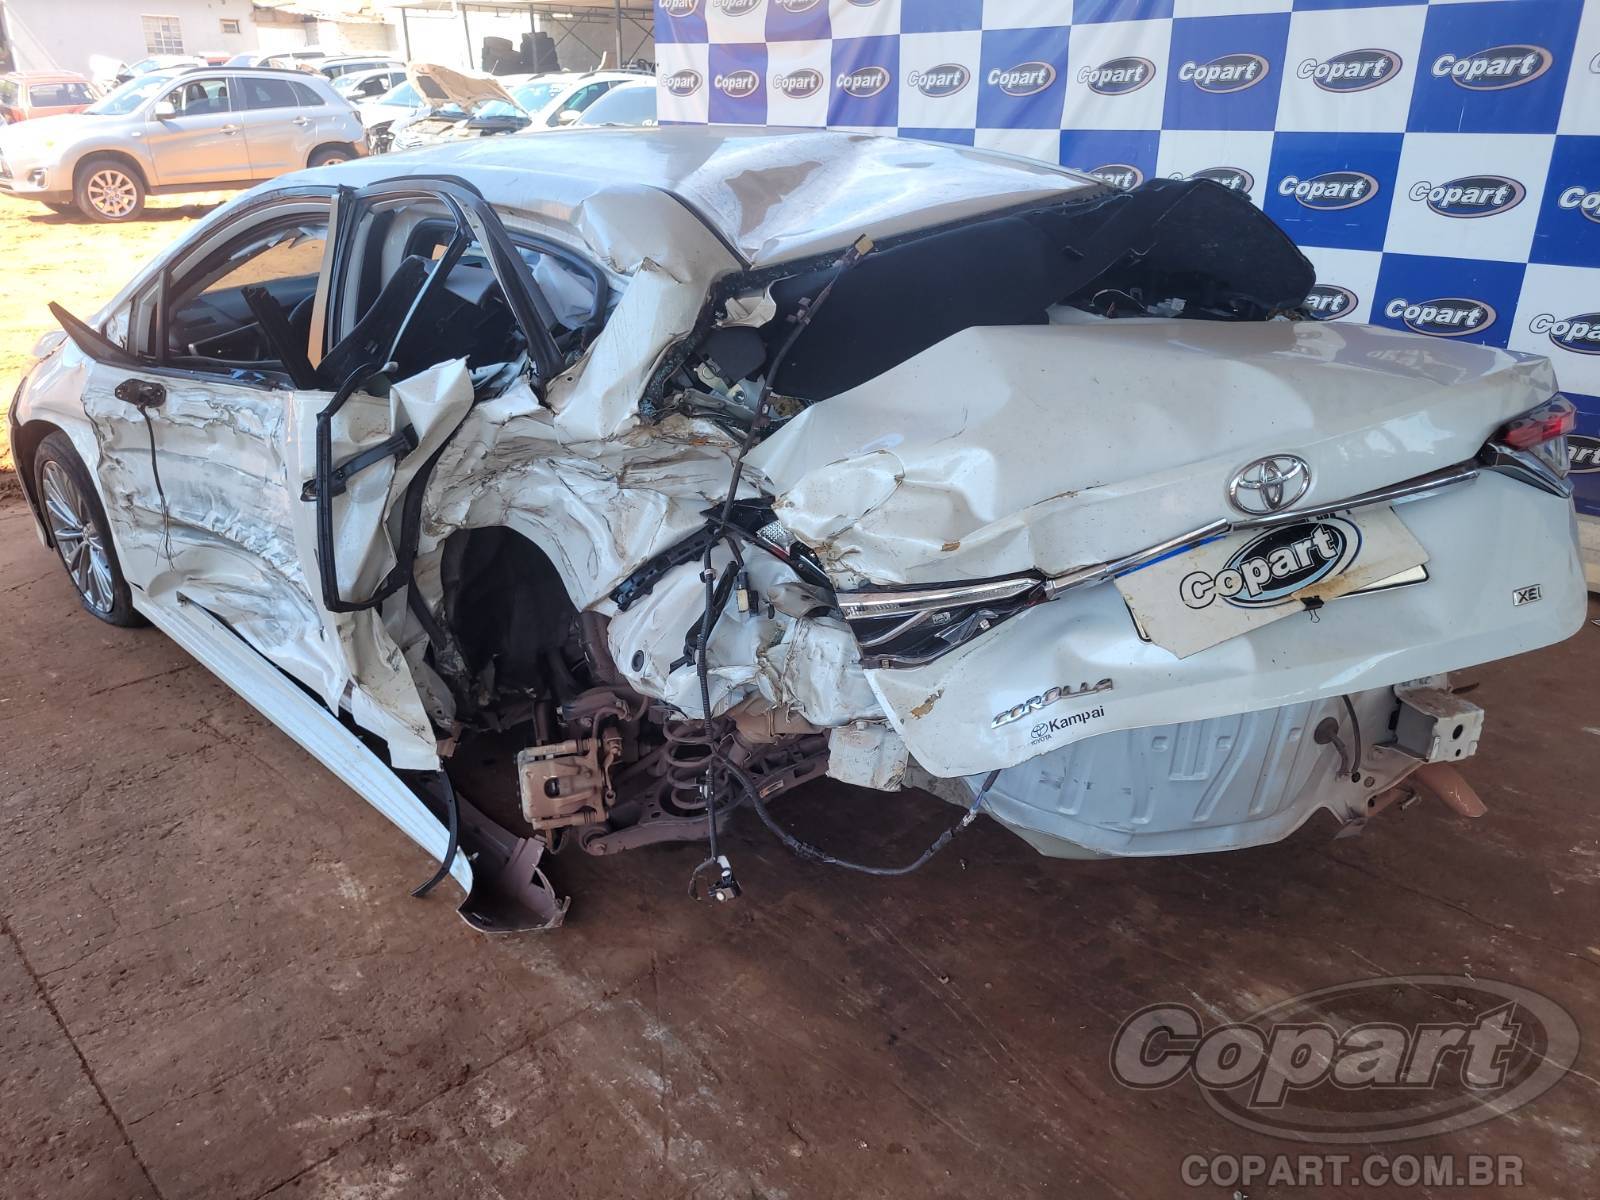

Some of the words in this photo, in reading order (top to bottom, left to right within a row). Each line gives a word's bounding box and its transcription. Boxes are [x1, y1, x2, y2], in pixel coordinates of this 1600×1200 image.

[987, 66, 1047, 87] Copart
[1077, 63, 1145, 87] Copart
[1178, 59, 1258, 84] Copart
[1297, 56, 1389, 83] Copart
[1431, 50, 1538, 83] Copart
[661, 74, 694, 90] Copart
[714, 74, 754, 91] Copart
[773, 73, 816, 92] Copart
[836, 71, 883, 92] Copart
[907, 68, 962, 91] Copart
[1278, 175, 1368, 200] Copart
[1409, 180, 1511, 209] Copart
[1384, 298, 1484, 328] Copart
[1180, 523, 1338, 609] Copart
[991, 678, 1113, 729] COROLLA
[1048, 705, 1105, 732] Kampai
[1031, 734, 1052, 746] TOYOTA
